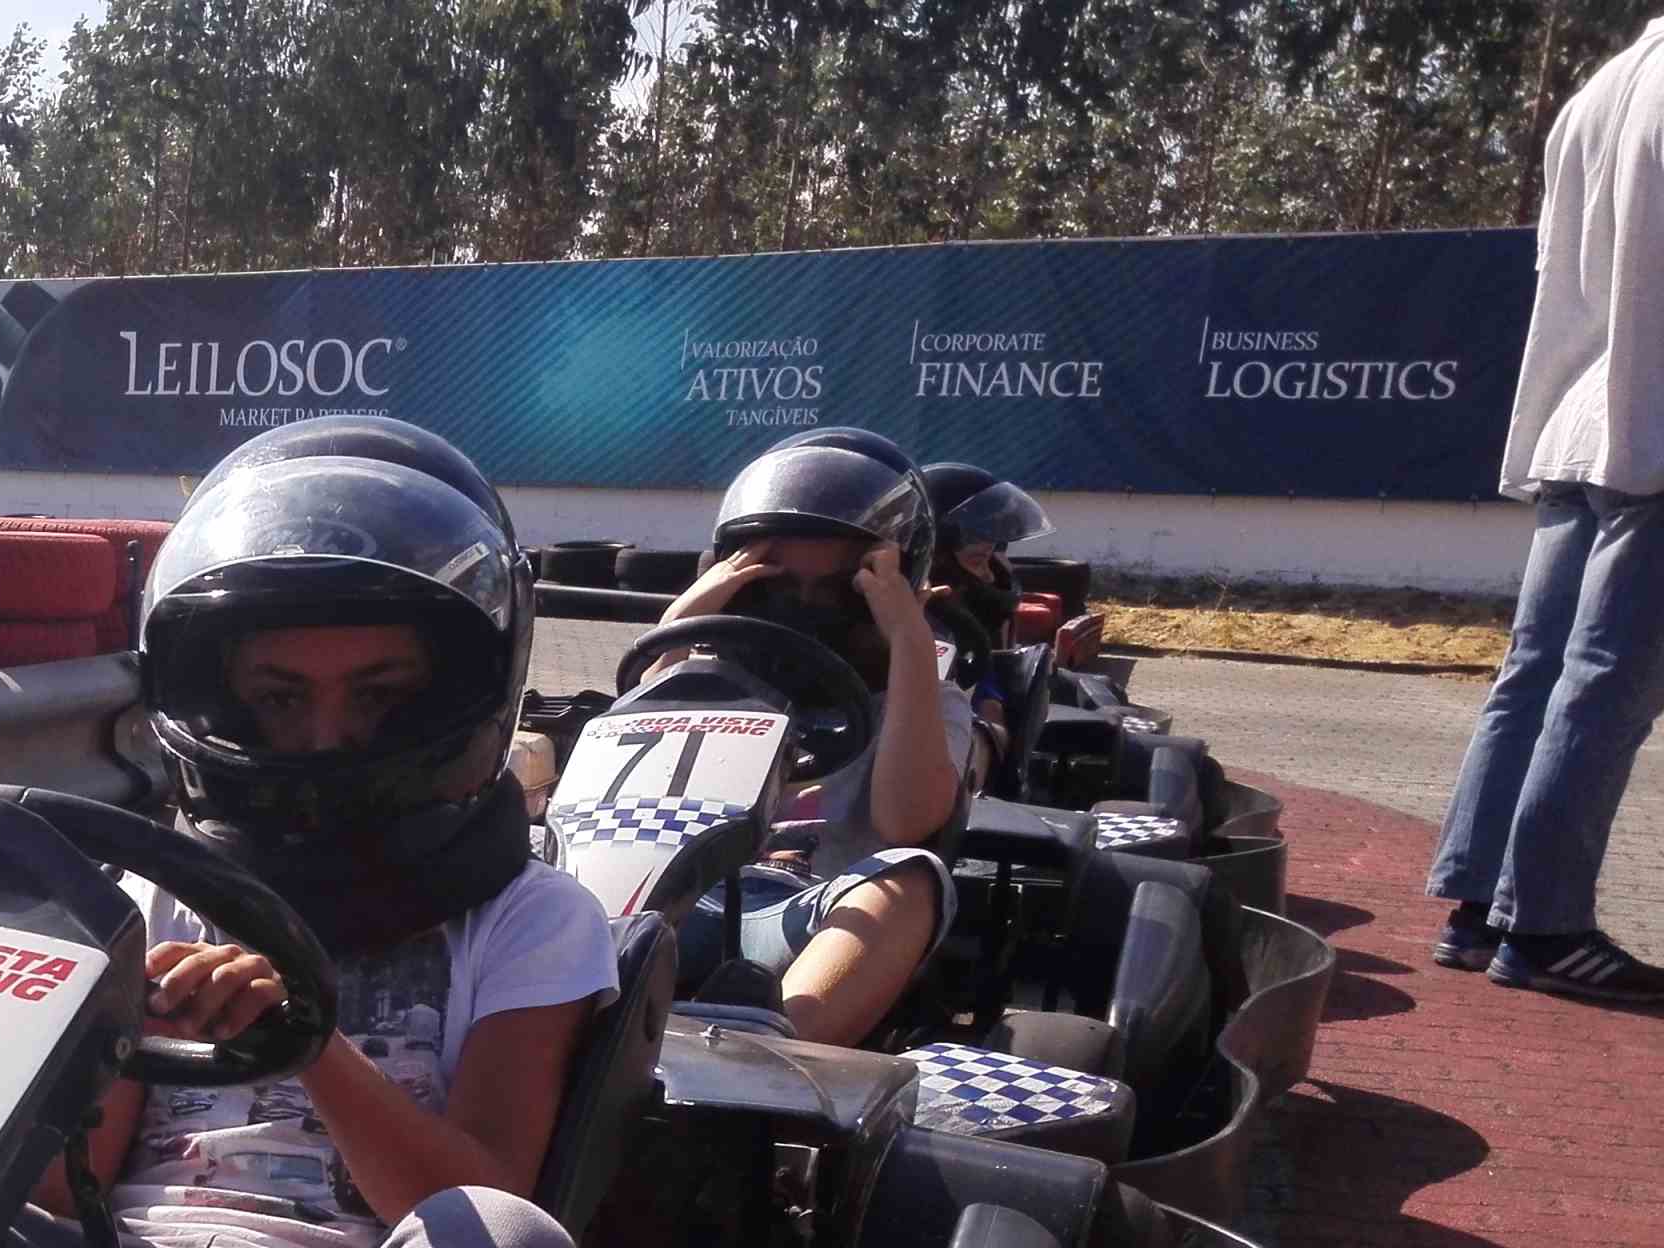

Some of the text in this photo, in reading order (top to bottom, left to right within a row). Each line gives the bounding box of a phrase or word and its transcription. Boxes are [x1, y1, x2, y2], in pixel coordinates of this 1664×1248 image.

[691, 336, 819, 360] VALORIZAÇÃO
[920, 332, 1047, 351] CORPORATE
[1211, 331, 1320, 350] BUSINESS
[684, 365, 825, 401] ATIVOS
[915, 361, 1104, 397] FINANCE
[1204, 361, 1458, 400] LOGISTICS
[218, 407, 292, 427] MARKET
[726, 405, 819, 427] TANGÍVEIS
[638, 716, 776, 728] BOA VISTA
[601, 731, 706, 804] 71
